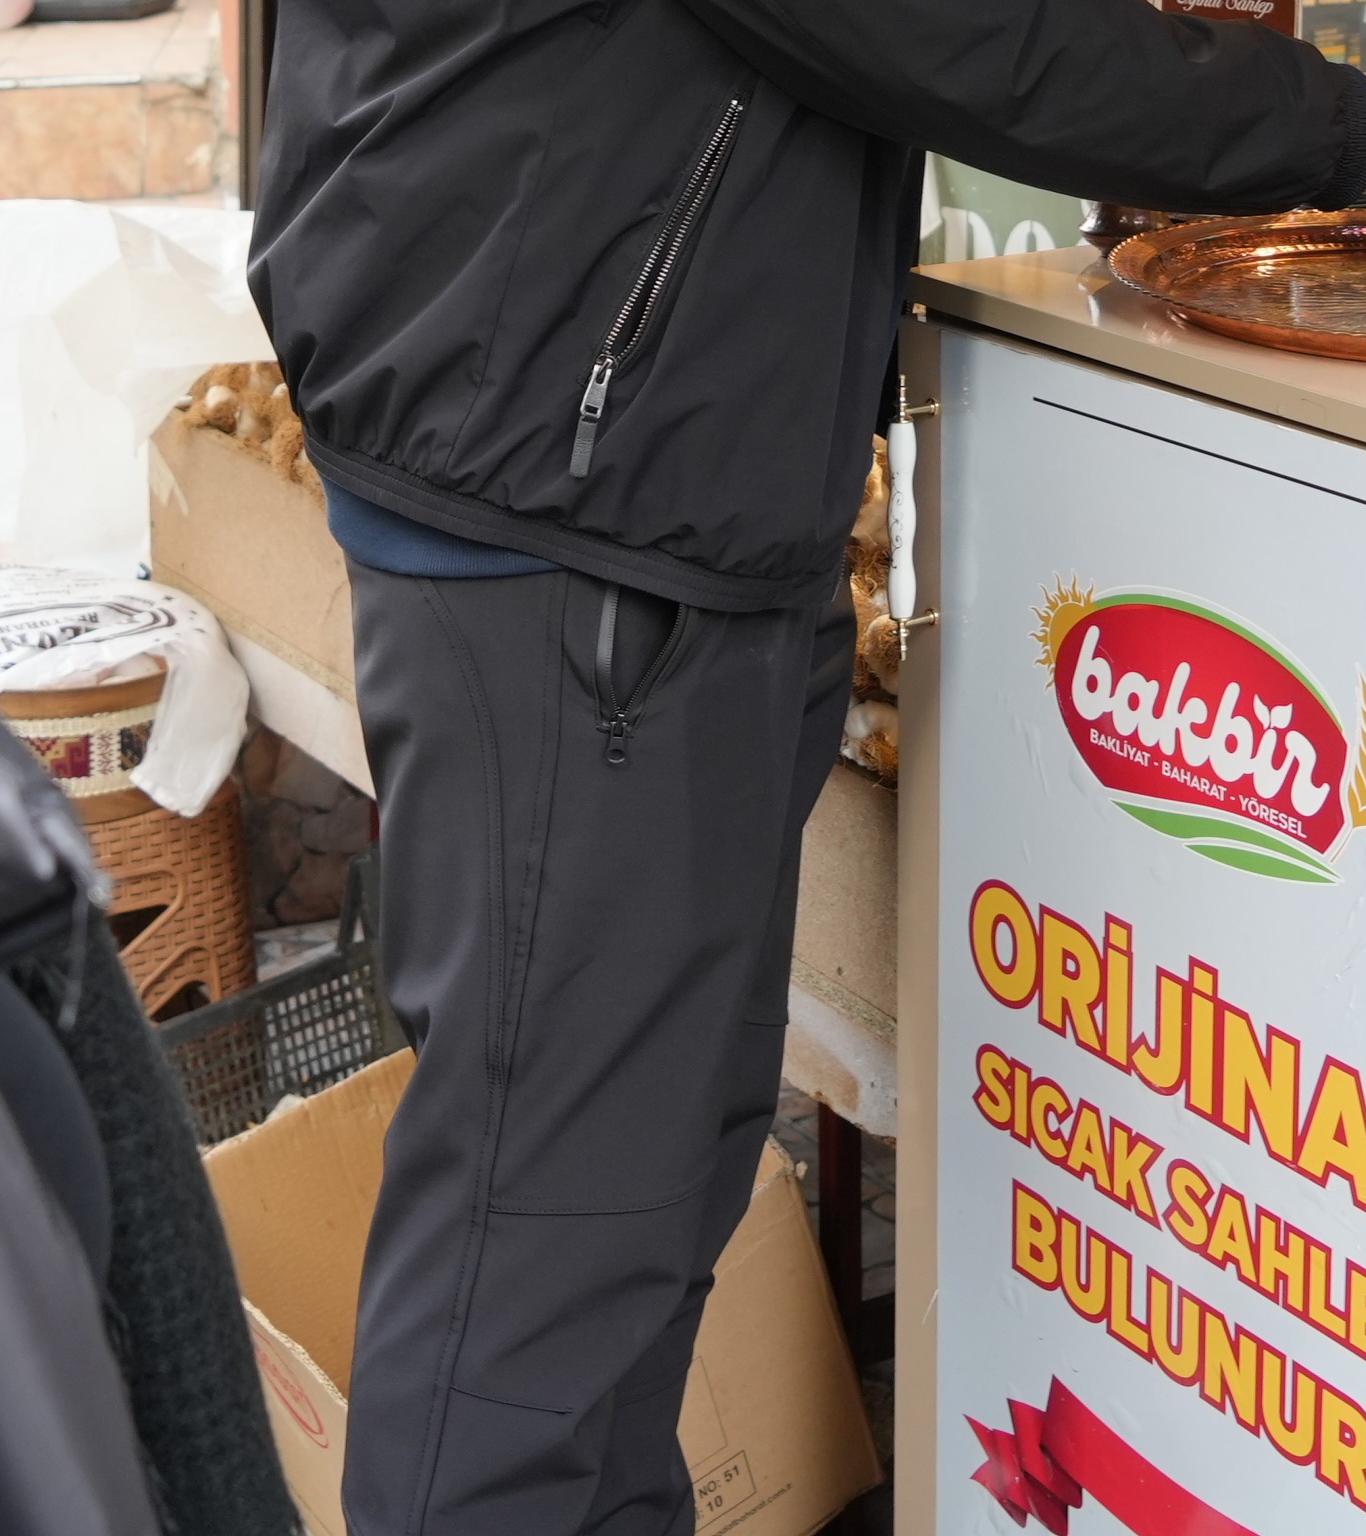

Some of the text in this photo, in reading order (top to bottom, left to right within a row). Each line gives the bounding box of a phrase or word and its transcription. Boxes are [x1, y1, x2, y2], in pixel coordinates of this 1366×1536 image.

[1071, 624, 1331, 817] bakbir
[1089, 727, 1152, 768] BAKLİYAT
[1161, 761, 1228, 802] BAHARAT
[1238, 792, 1308, 839] YÖRESEL
[972, 1043, 1164, 1231] SICAK
[705, 1494, 724, 1513] 10
[723, 1464, 741, 1484] 51
